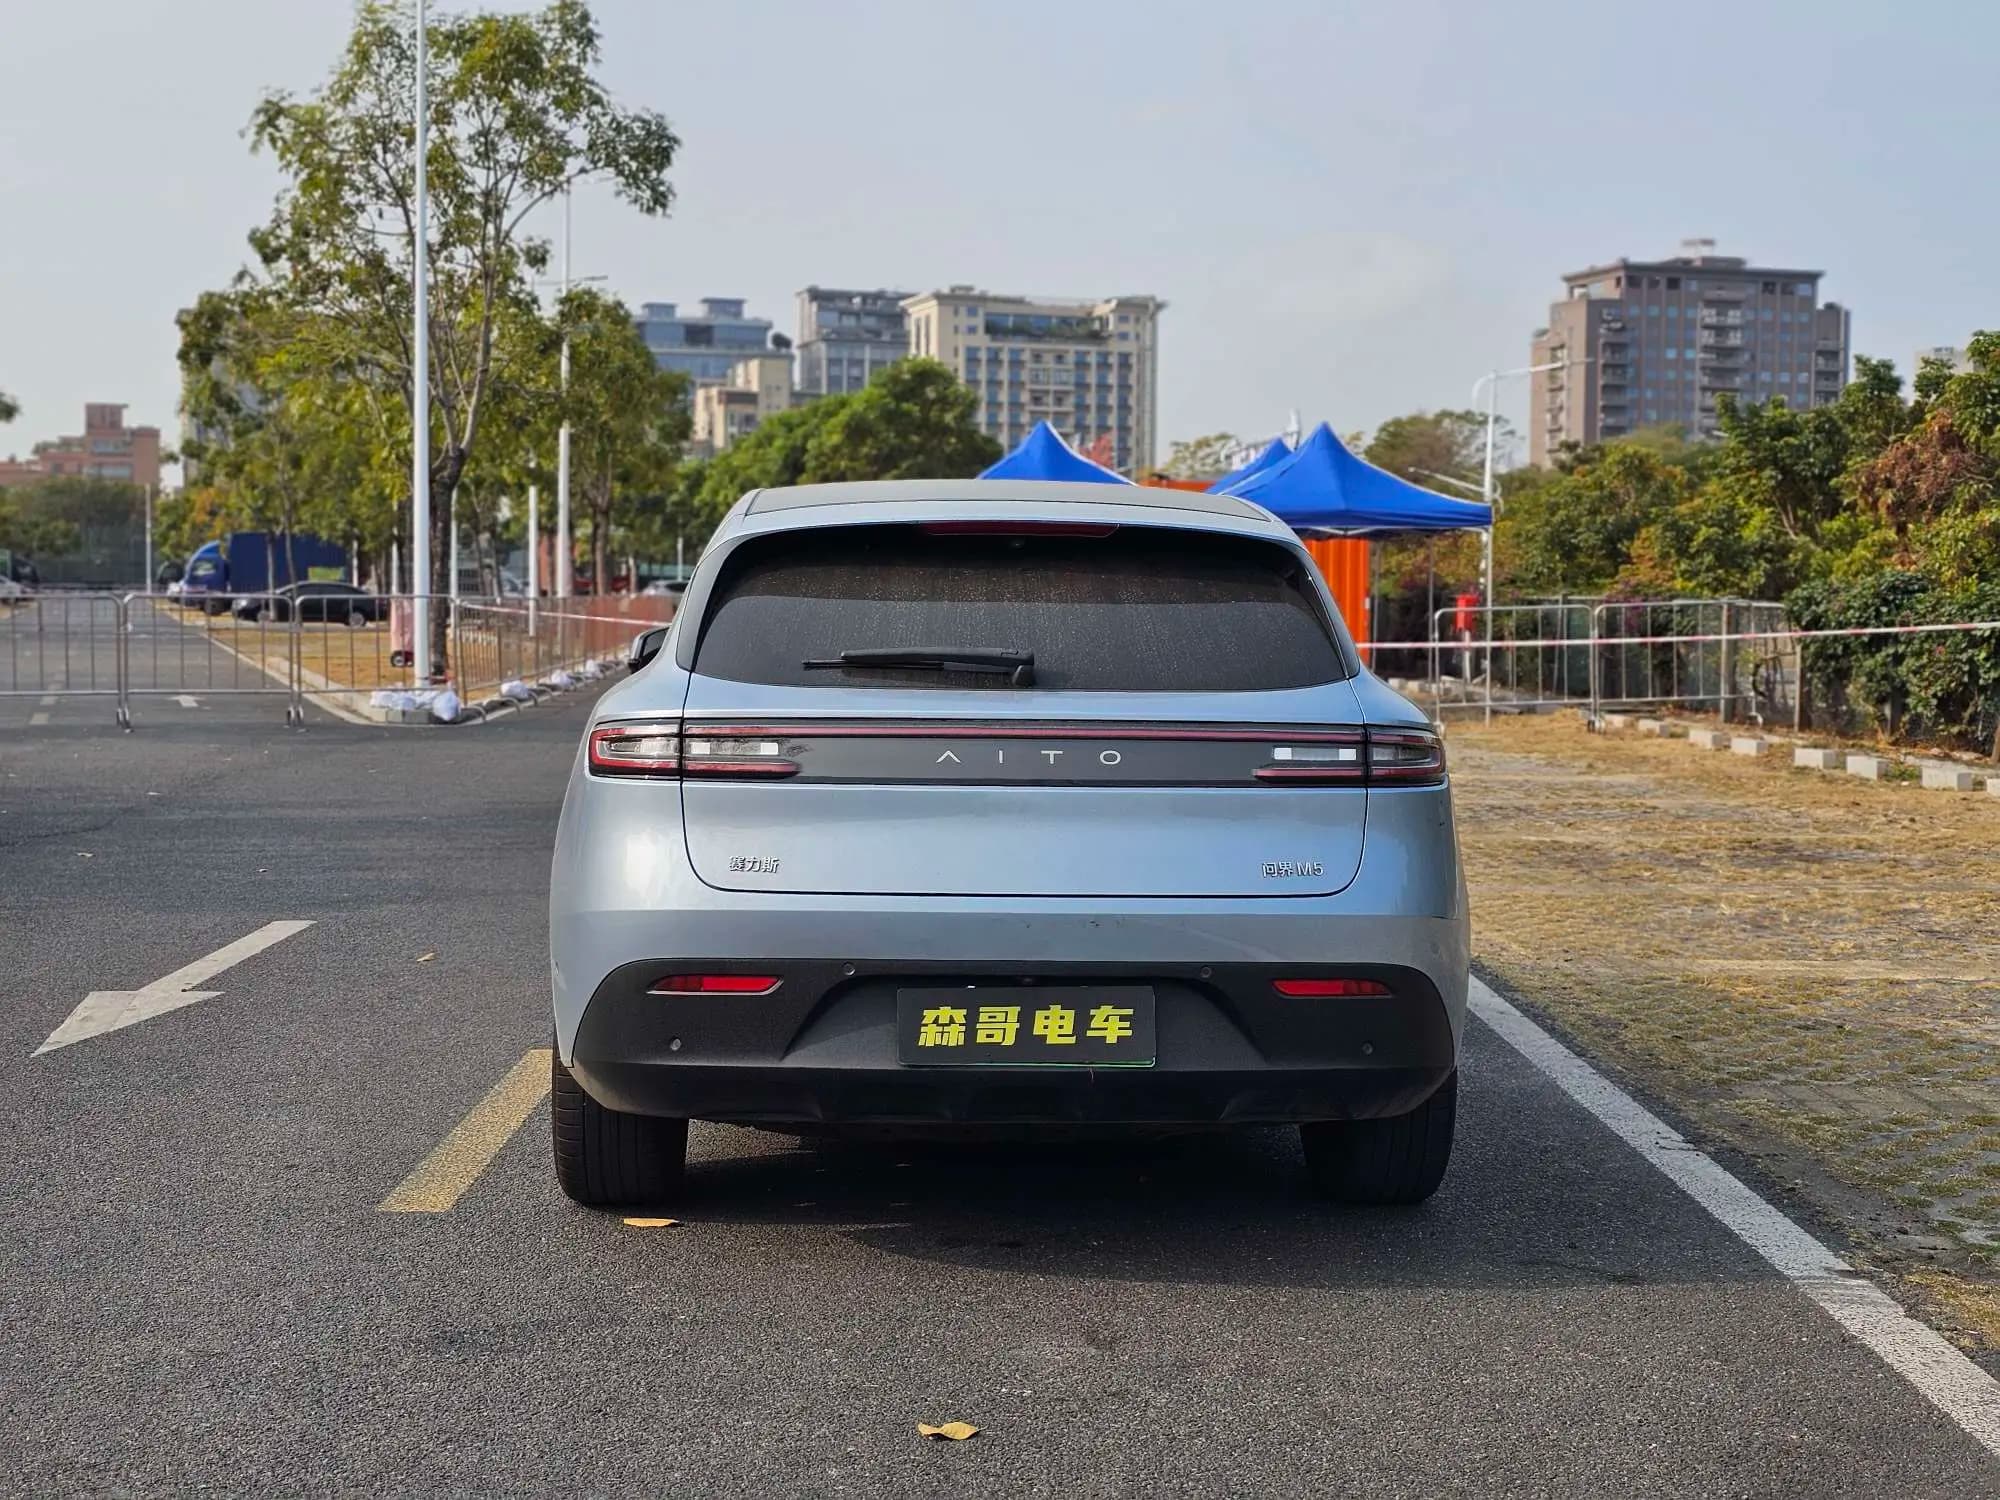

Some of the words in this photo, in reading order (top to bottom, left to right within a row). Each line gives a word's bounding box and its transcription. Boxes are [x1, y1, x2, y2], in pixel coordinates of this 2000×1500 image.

[936, 750, 1121, 765] AITO
[729, 855, 779, 874] 赛力斯
[918, 1004, 1134, 1047] 森哥电车
